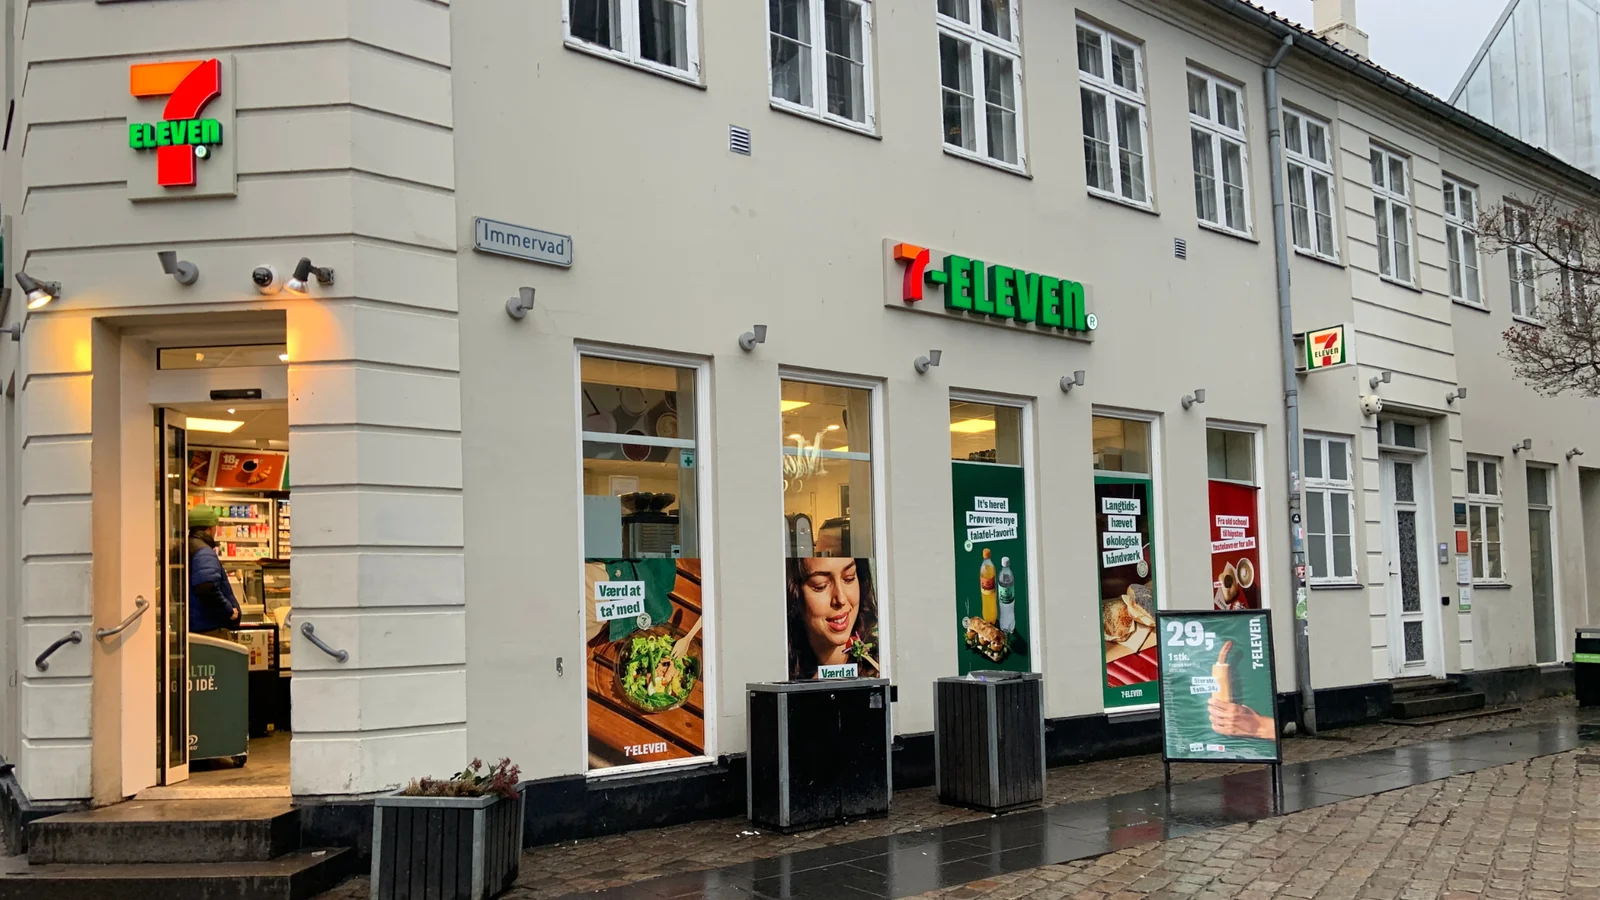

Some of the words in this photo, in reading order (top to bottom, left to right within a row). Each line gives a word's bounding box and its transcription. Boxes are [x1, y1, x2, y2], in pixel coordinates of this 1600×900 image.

[130, 58, 220, 186] 7
[484, 222, 564, 256] Immervad
[989, 500, 1006, 510] here!
[1105, 500, 1138, 513] Langtids-
[985, 516, 1003, 524] vores
[1003, 517, 1015, 526] nye
[1111, 517, 1133, 528] hævet
[1106, 535, 1140, 548] økologisk
[1105, 550, 1141, 565] håndværk
[598, 584, 628, 597] Værd
[629, 584, 641, 597] at
[616, 601, 640, 615] med
[821, 667, 845, 678] Værd
[845, 667, 856, 677] at
